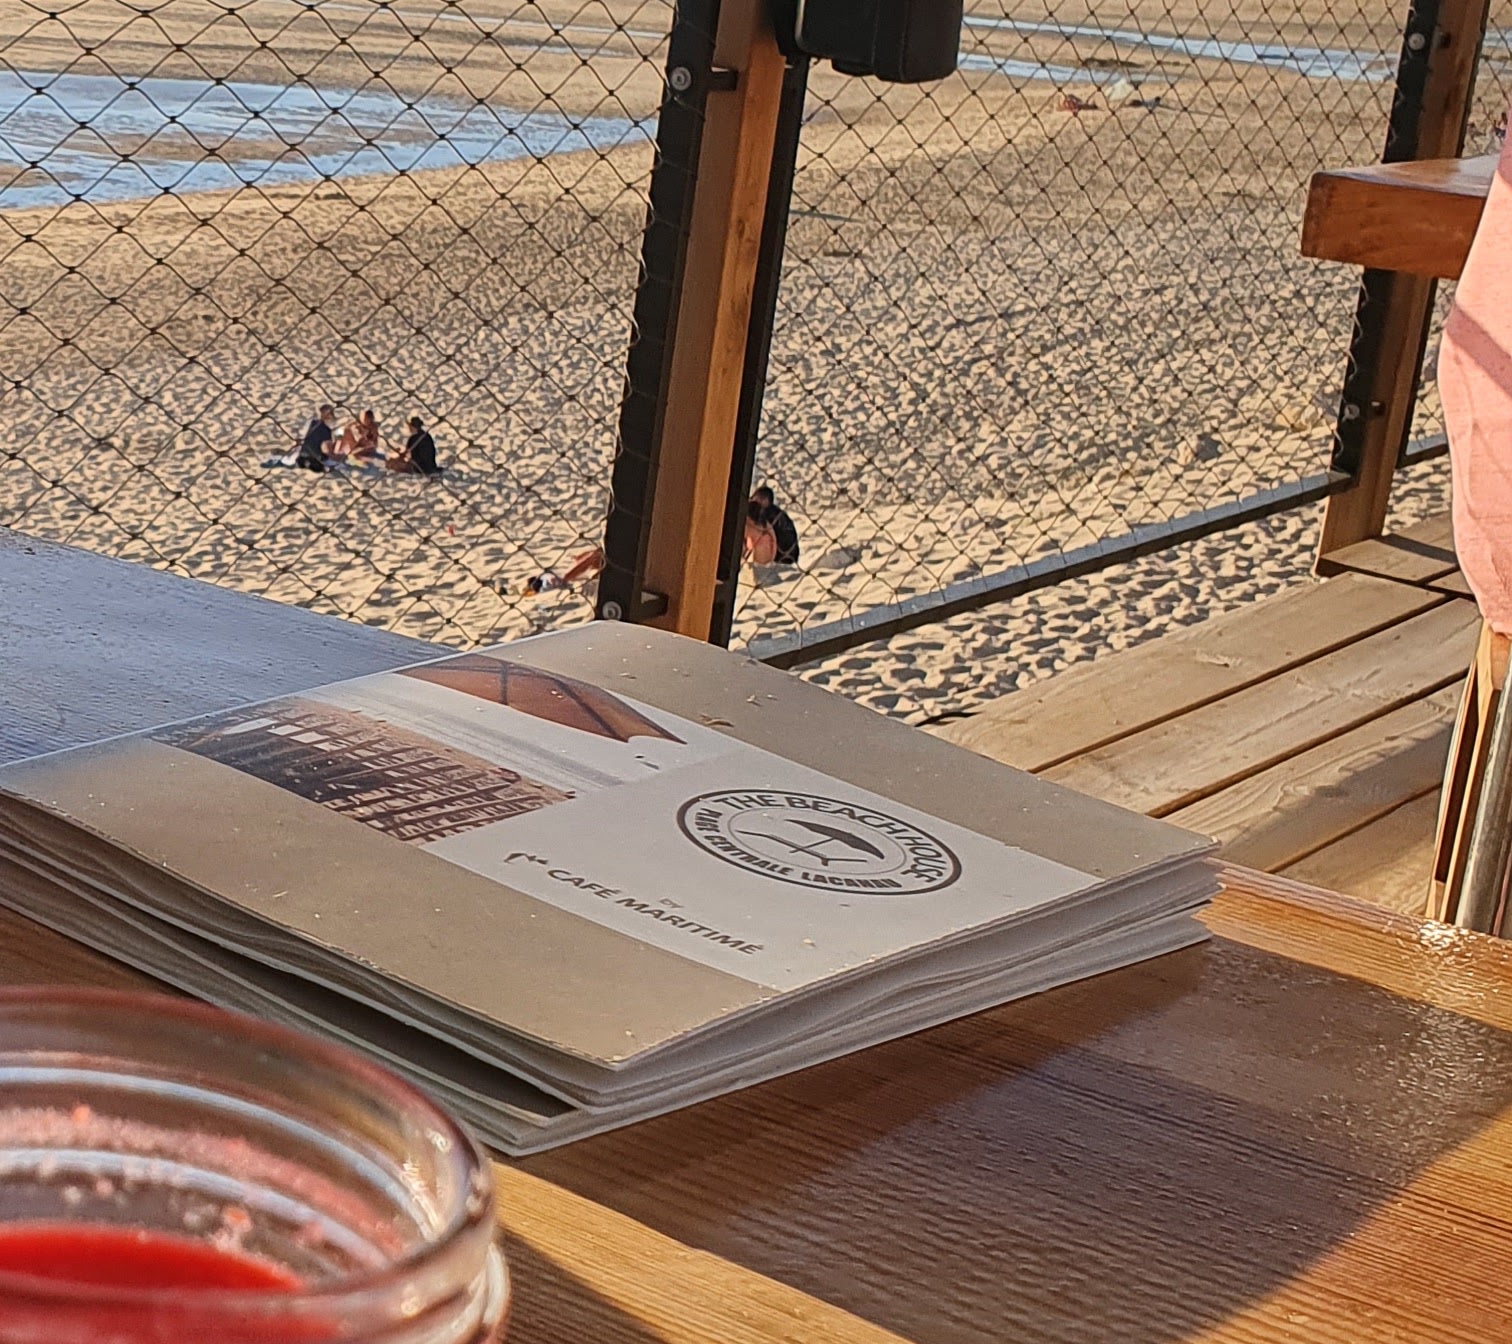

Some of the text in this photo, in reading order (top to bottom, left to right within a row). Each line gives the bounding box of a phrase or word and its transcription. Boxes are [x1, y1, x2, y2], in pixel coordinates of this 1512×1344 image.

[704, 835, 795, 876] CENTRALE
[801, 871, 903, 889] LACANAU
[713, 794, 948, 884] THE BEACH HOUSE
[547, 869, 622, 900] CAFÉ
